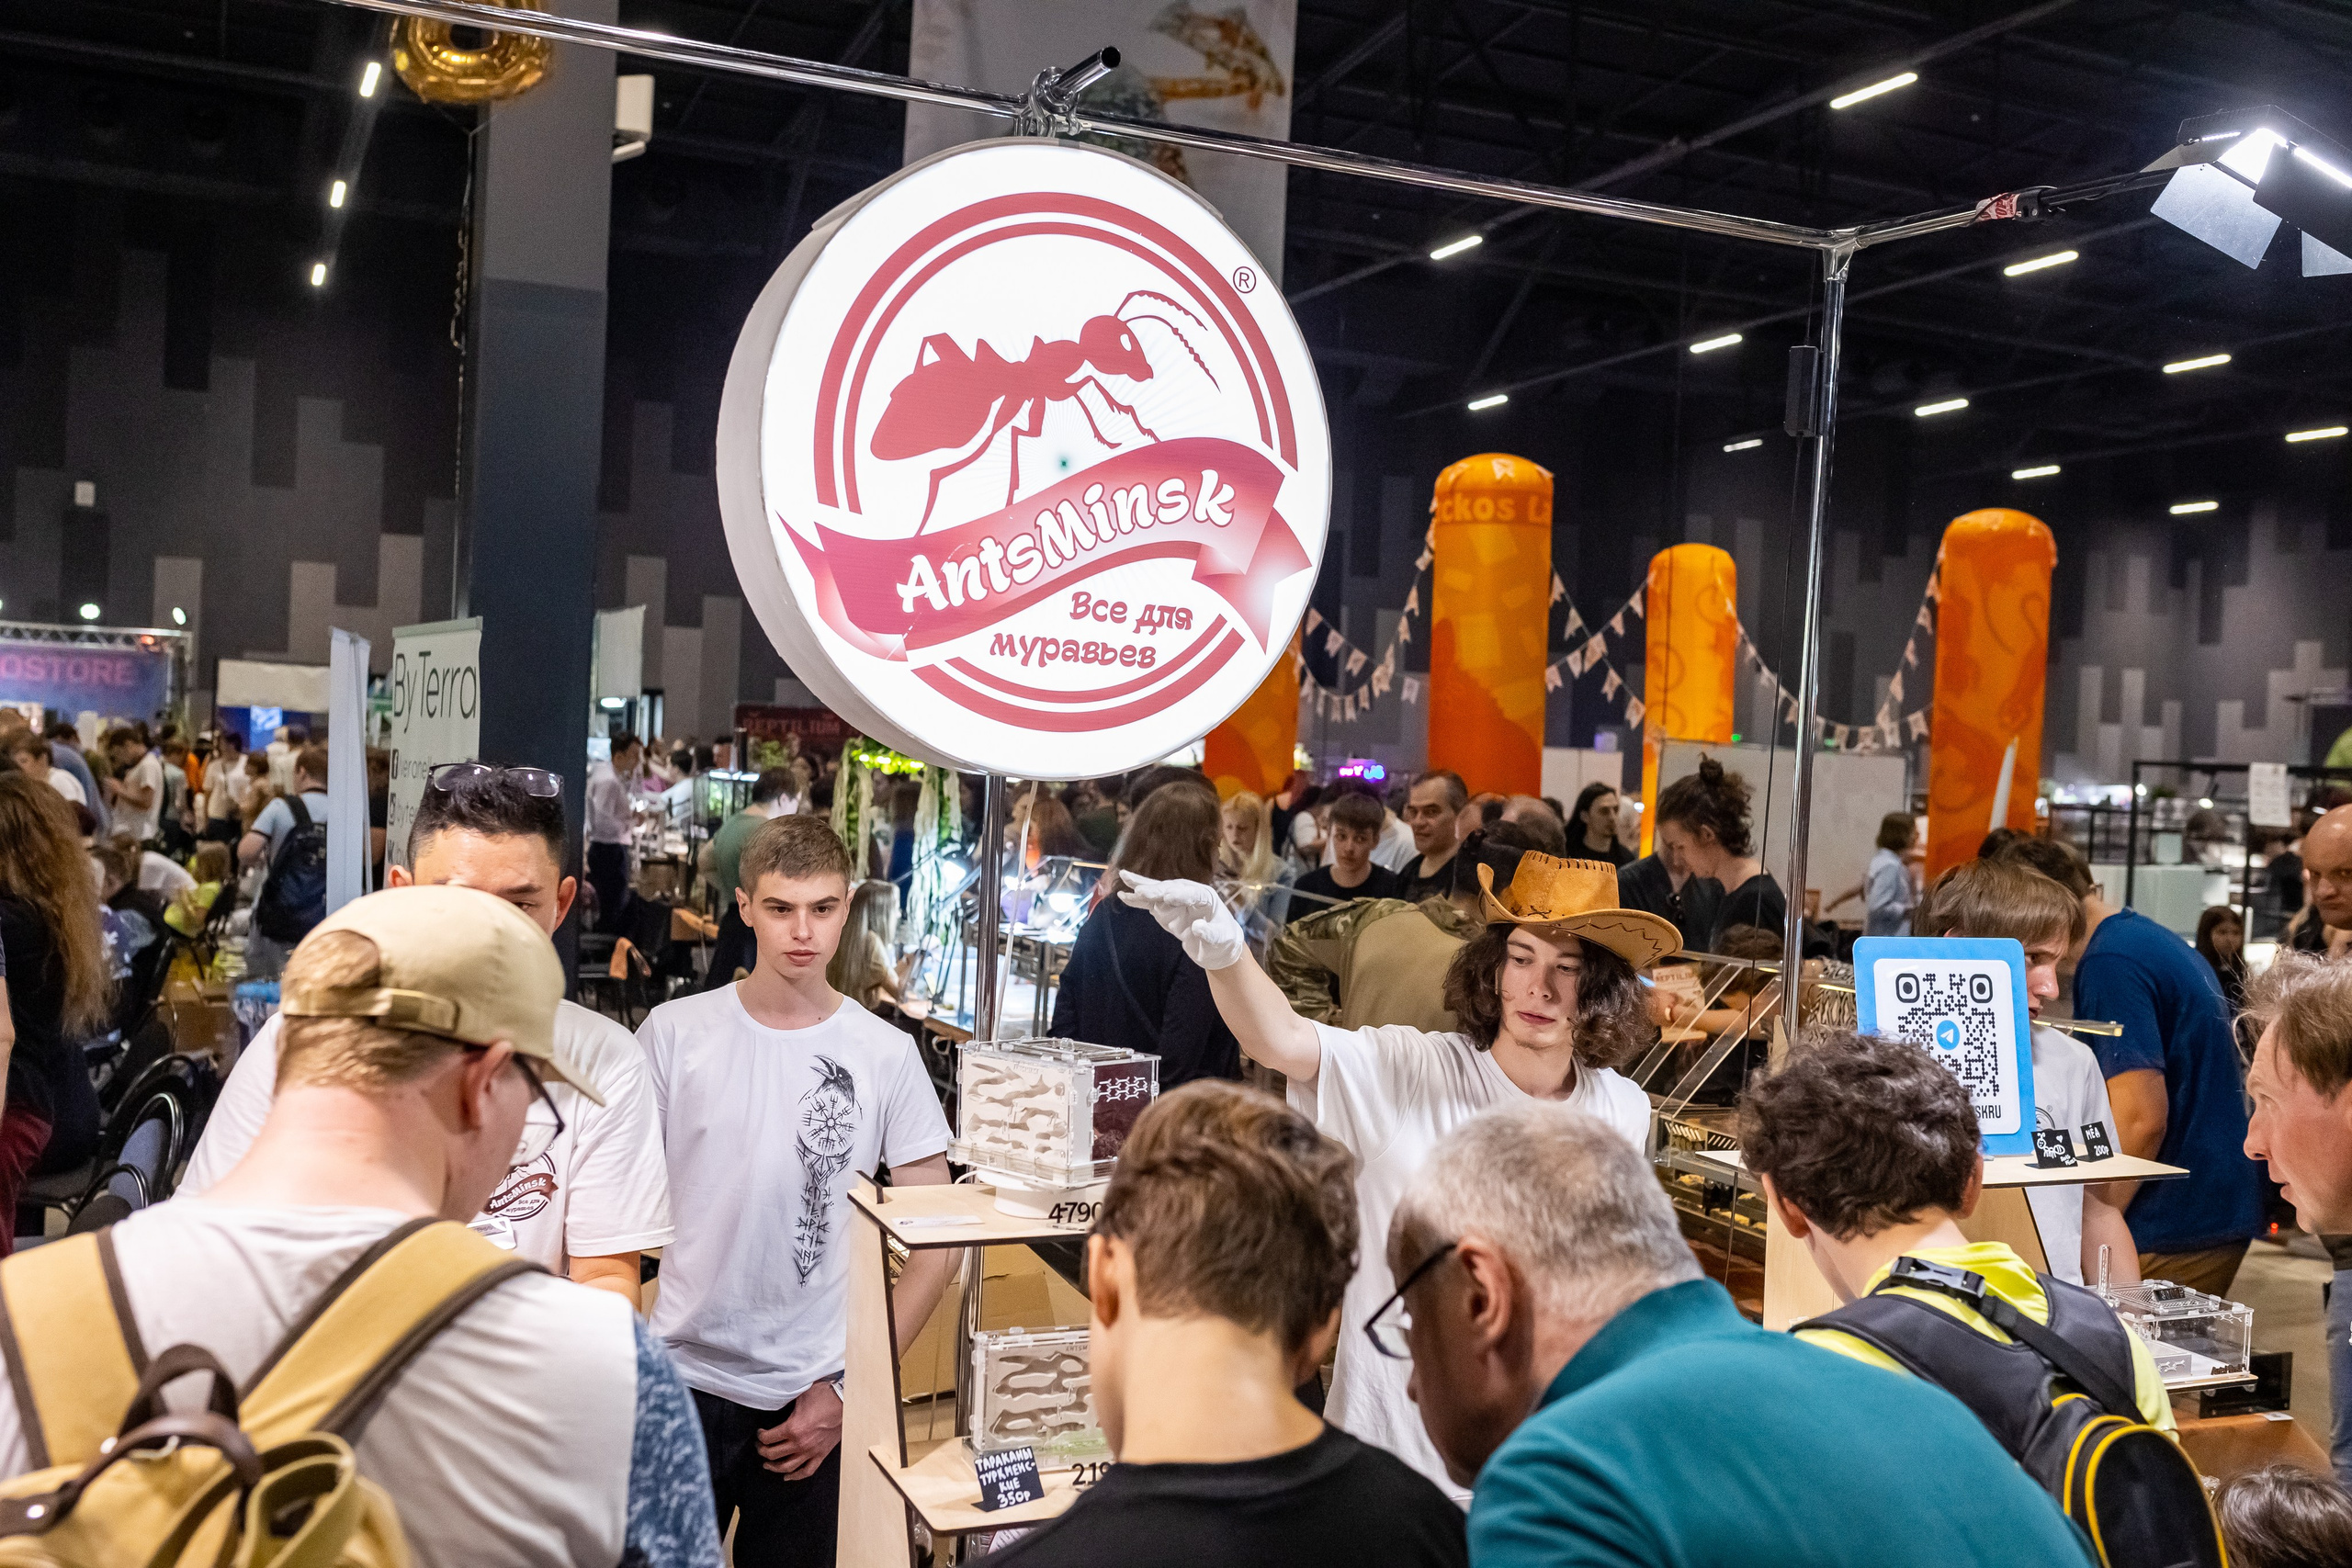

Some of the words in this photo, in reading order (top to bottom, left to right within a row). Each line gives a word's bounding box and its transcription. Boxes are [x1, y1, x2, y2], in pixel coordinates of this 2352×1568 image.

[896, 469, 1235, 614] AntsMinsk
[1069, 592, 1127, 624] Все
[1132, 604, 1193, 636] для
[989, 633, 1156, 669] муравьев
[1974, 1104, 2001, 1119] SKRU
[490, 1178, 546, 1210] AntsMinsk
[975, 1448, 1033, 1472] ТАРАКАНЫ
